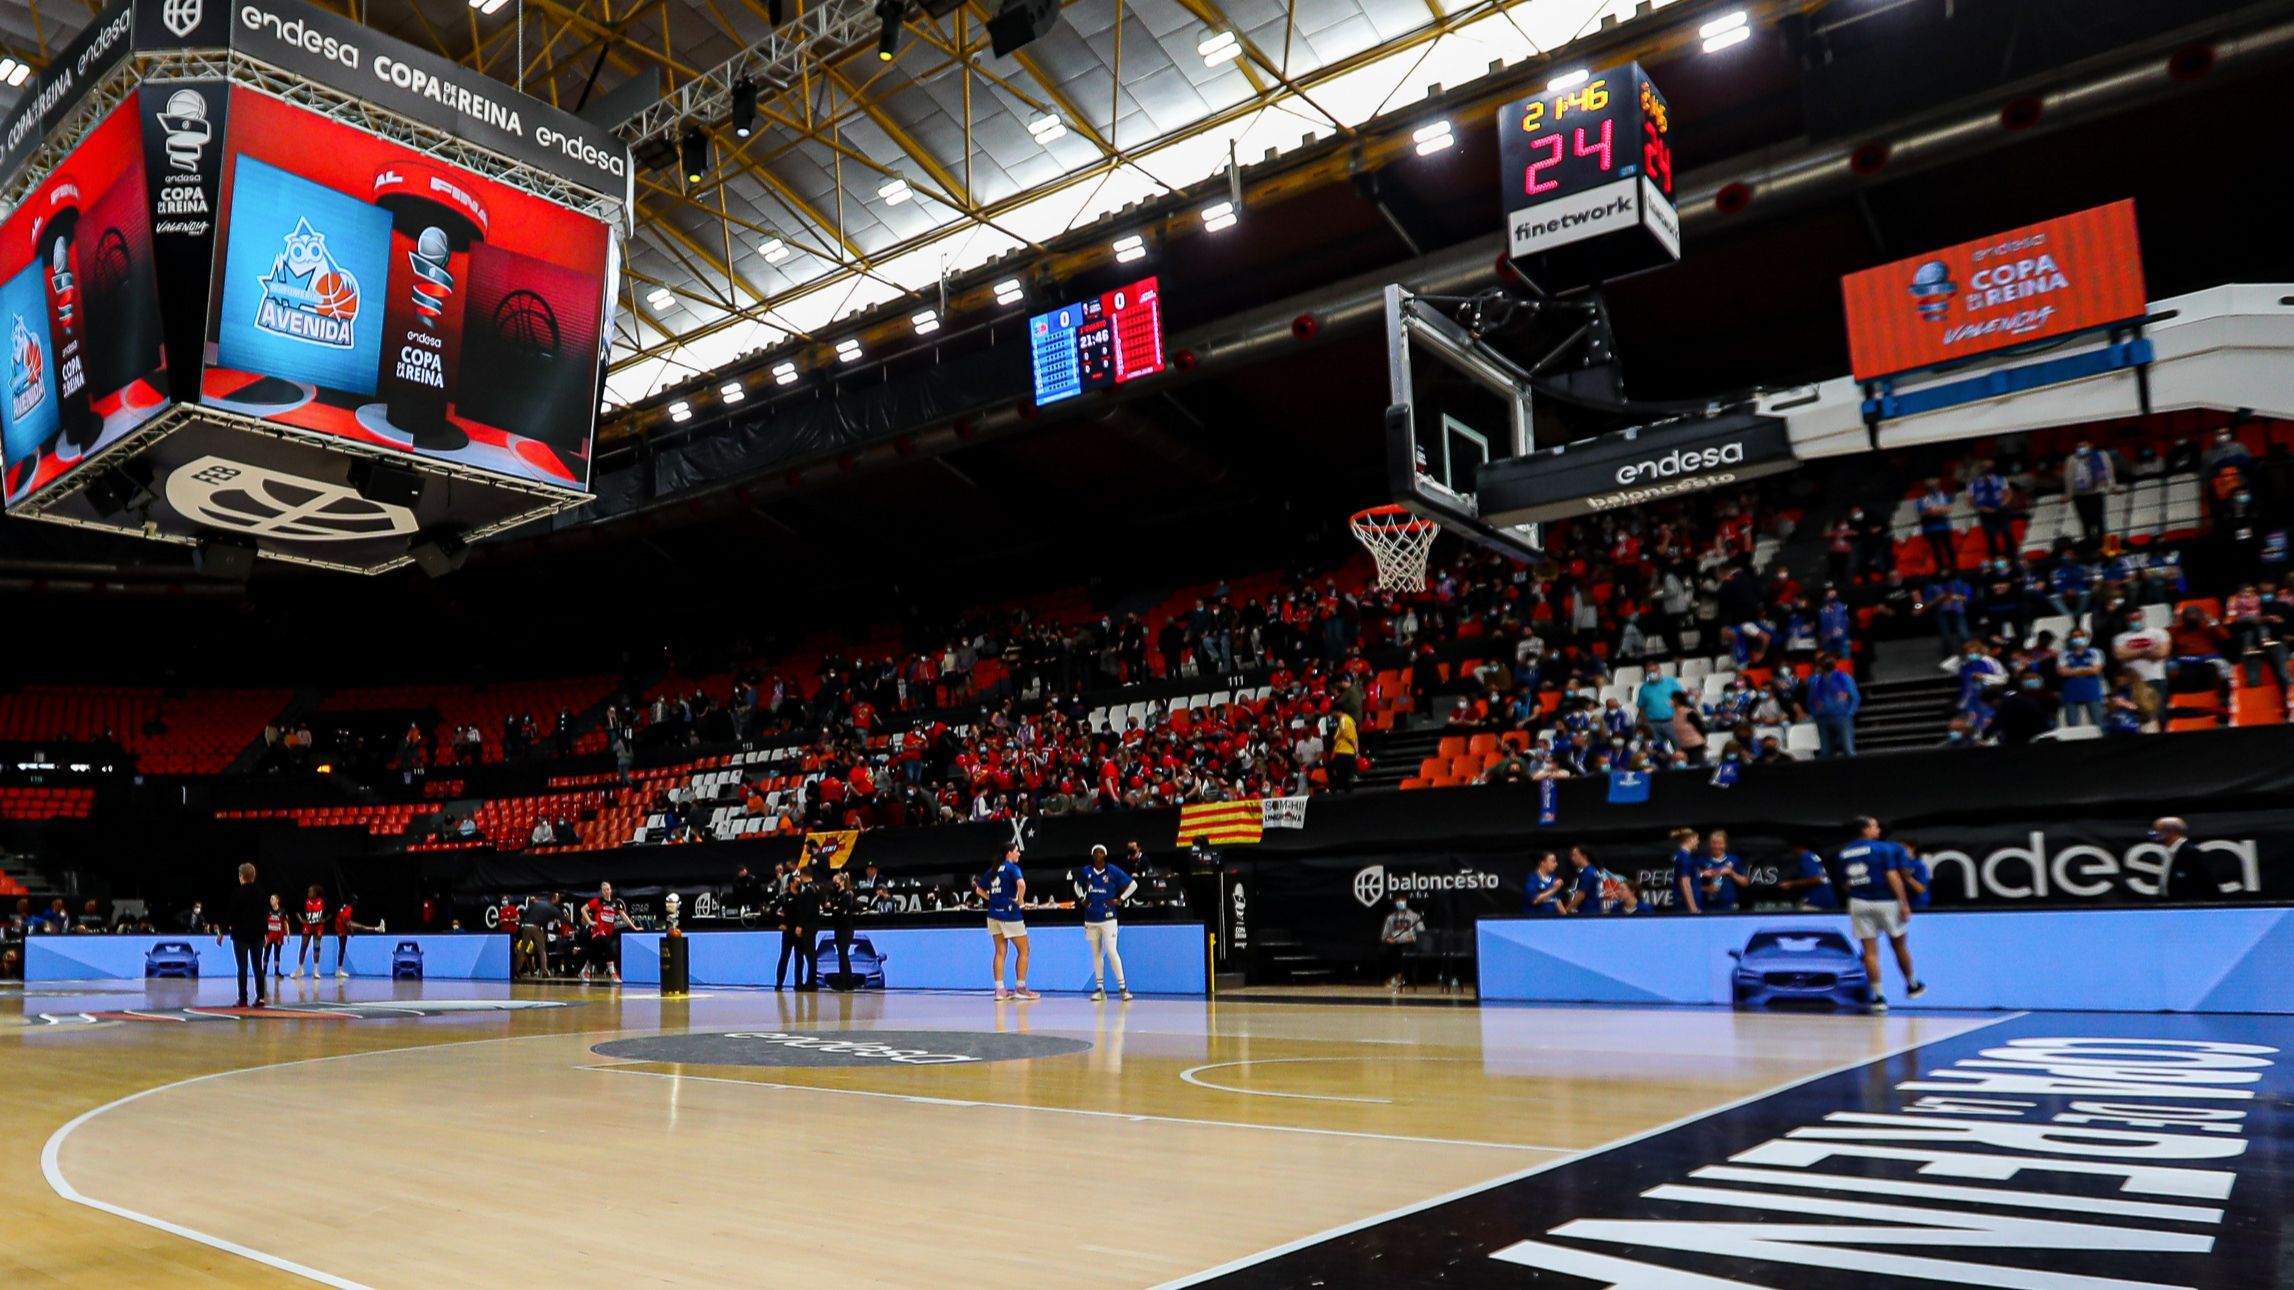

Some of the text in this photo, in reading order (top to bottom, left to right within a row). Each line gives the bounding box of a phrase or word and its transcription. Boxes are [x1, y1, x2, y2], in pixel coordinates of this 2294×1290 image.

[77, 7, 131, 77] endesa
[240, 5, 359, 70] endesa
[373, 55, 441, 102] COPA
[457, 88, 522, 136] REINA
[535, 126, 624, 177] endesa
[7, 67, 73, 151] COPA REINA
[1525, 119, 1614, 196] 24
[161, 187, 203, 201] COPA
[168, 200, 208, 213] REINA
[1515, 196, 1633, 242] finetwork
[1971, 254, 2057, 290] COPA
[1114, 292, 1126, 311] 0
[1985, 272, 2069, 306] REINA
[261, 300, 350, 344] AVENIDA
[1060, 311, 1070, 328] 0
[407, 331, 441, 348] endesa
[1080, 329, 1109, 349] 21:46
[62, 355, 81, 381] COPA
[400, 345, 441, 371] COPA
[406, 365, 444, 388] REINA
[191, 465, 242, 486] FEB
[1615, 442, 1743, 485] endesa
[631, 903, 650, 915] SPAR
[724, 1032, 983, 1064] endesa
[1894, 1037, 2281, 1099] COPA
[1489, 1111, 2249, 1290] REIN
